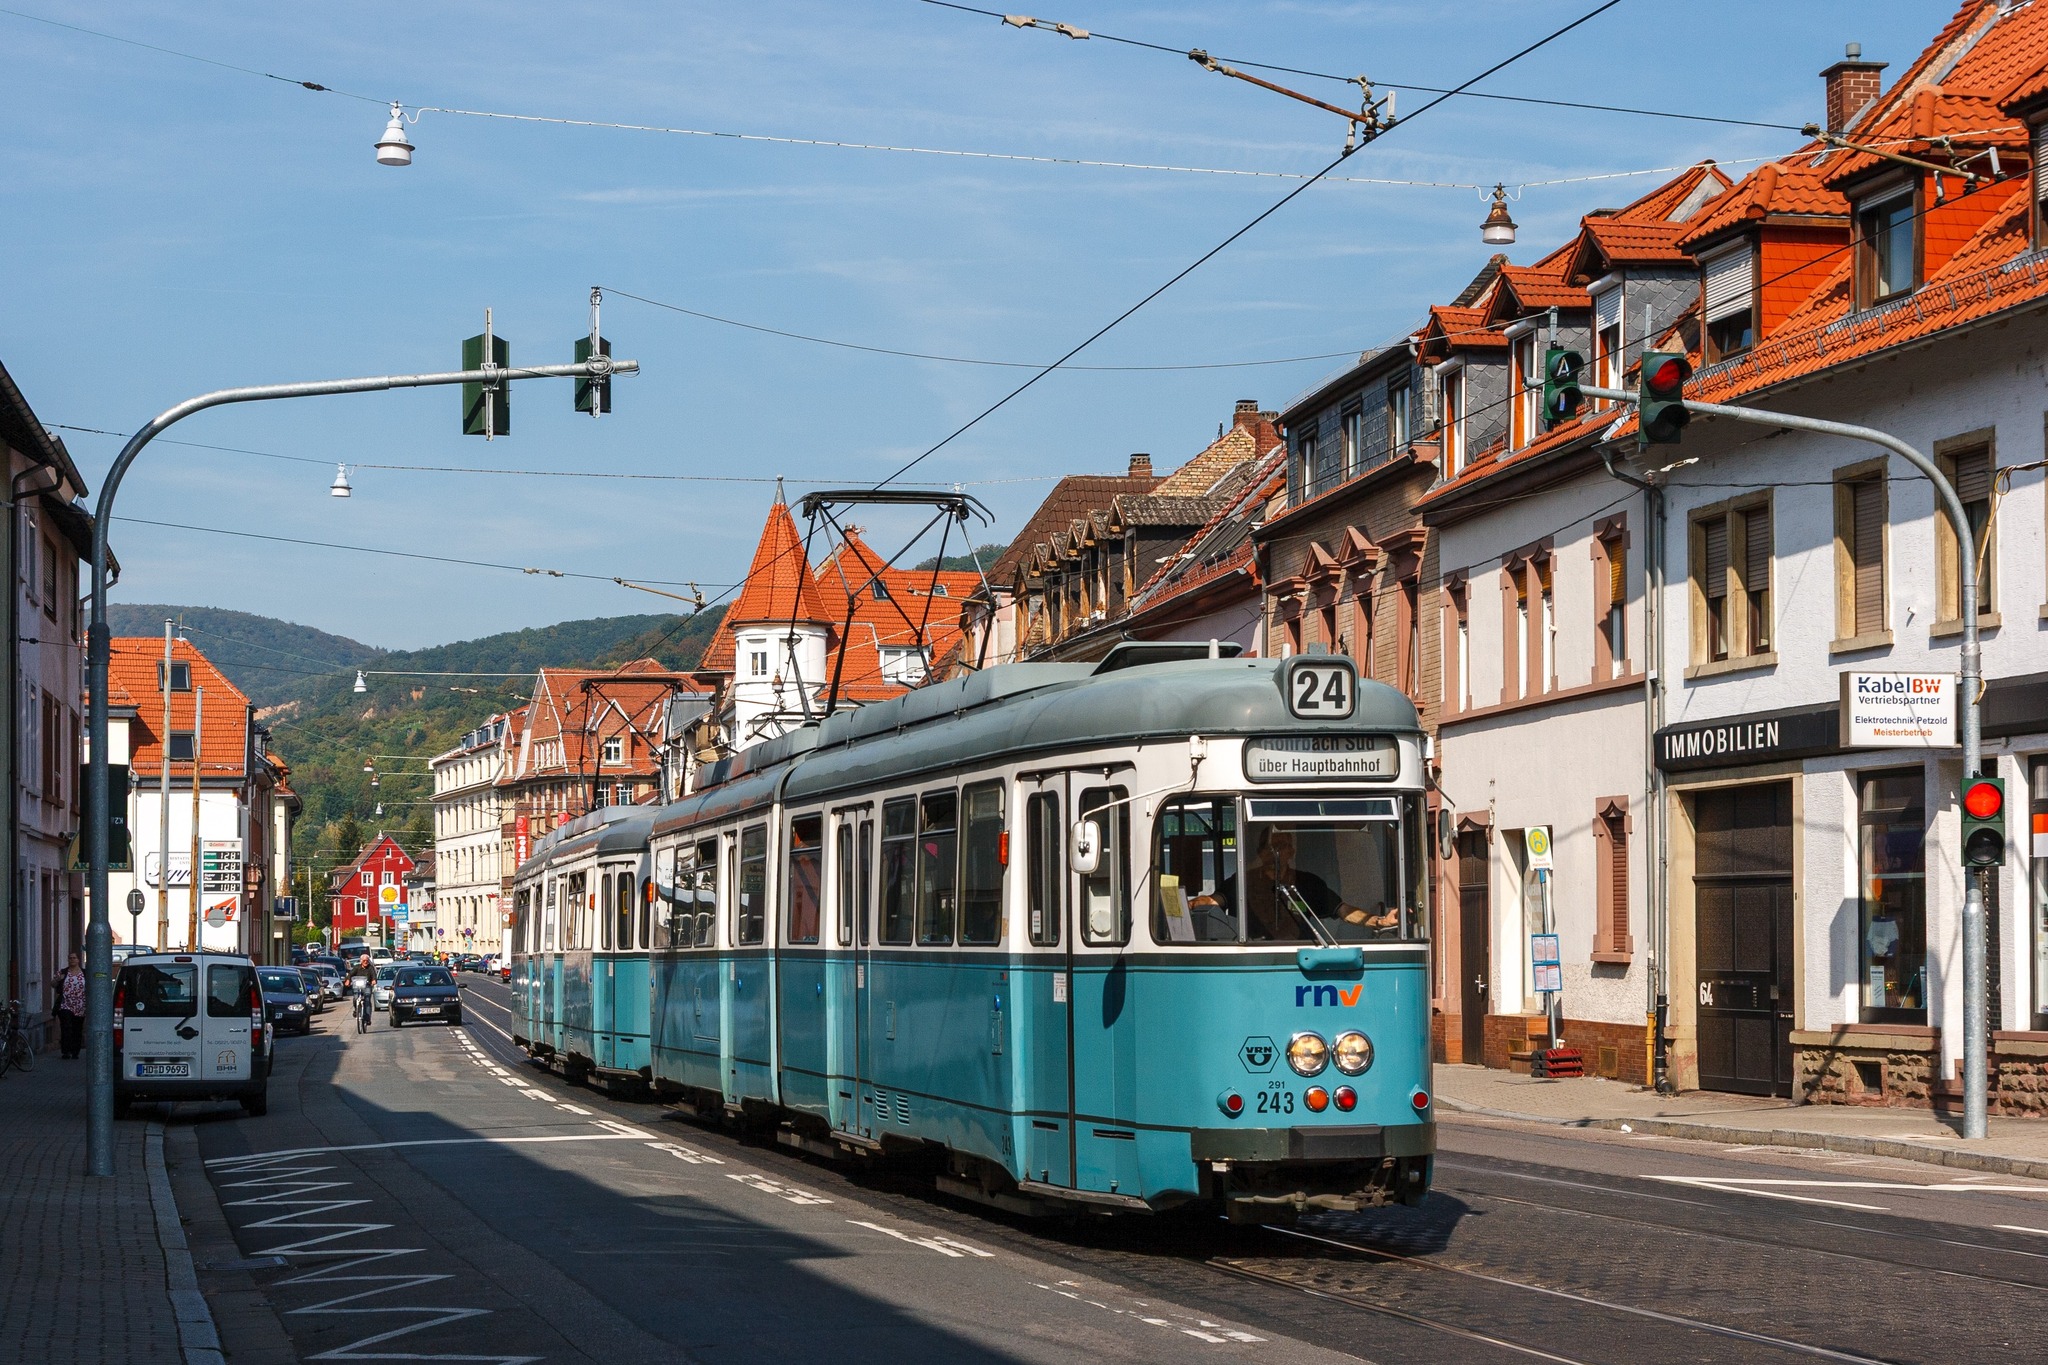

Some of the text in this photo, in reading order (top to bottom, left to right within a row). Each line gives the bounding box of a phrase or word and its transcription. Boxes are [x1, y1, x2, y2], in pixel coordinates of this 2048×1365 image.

[1297, 670, 1347, 709] 24
[1858, 676, 1942, 693] KabelBW
[1858, 695, 1941, 706] Vertriebspartner
[1855, 716, 1915, 724] Elektrotechnik
[1873, 728, 1933, 736] Meisterbetrieb
[1665, 721, 1779, 760] IMMOBILIEN
[1259, 759, 1381, 775] über Hauptbahnhof
[1295, 984, 1364, 1007] rnv
[1700, 981, 1713, 1006] 64
[1245, 1046, 1272, 1054] VRN
[142, 1065, 154, 1074] HD
[165, 1065, 187, 1074] 9693
[1268, 1081, 1285, 1089] 291
[1257, 1091, 1295, 1114] 243
